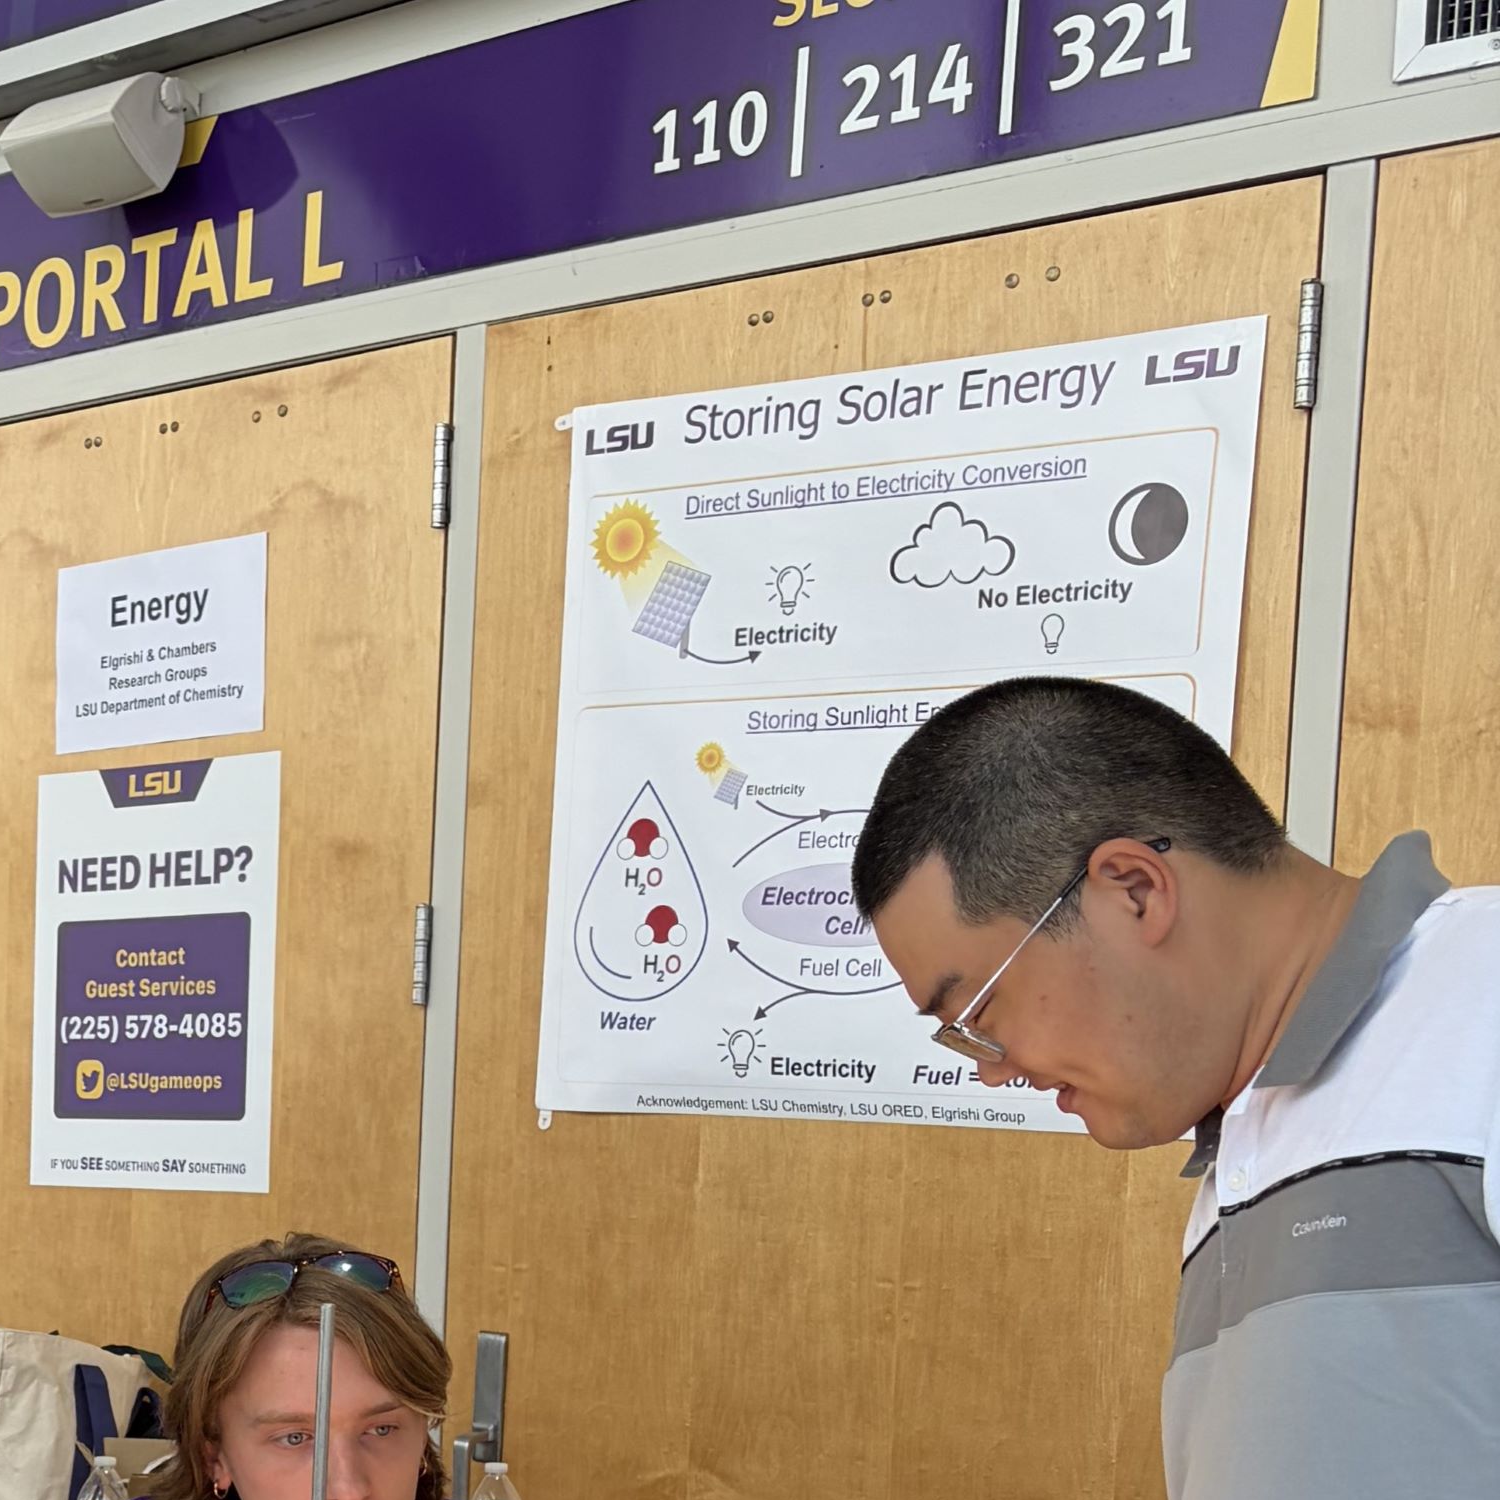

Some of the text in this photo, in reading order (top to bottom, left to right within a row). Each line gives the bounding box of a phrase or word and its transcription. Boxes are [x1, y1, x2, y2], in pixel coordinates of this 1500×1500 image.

[652, 0, 1192, 175] 110 214 321
[302, 190, 344, 288] L
[585, 345, 1241, 456] LSU Storing Solar Energy LSU
[685, 456, 1087, 516] Direct Sunlight to Electricity Conversion
[977, 578, 1133, 609] No Electricity
[110, 588, 209, 628] Energy
[734, 622, 838, 647] Electricity
[100, 640, 217, 671] Elgrishi & Chambers
[108, 664, 208, 690] Research Groups
[75, 683, 244, 718] LSU Department of Chemistry
[747, 709, 818, 732] Storing
[825, 705, 908, 730] Sunlight
[128, 770, 182, 798] LSU
[746, 783, 805, 798] Electricity
[798, 831, 860, 849] Electro
[58, 845, 254, 894] NEED HELP?
[761, 886, 854, 906] Electroc
[825, 916, 866, 935] Cell
[116, 947, 185, 968] Contact
[800, 958, 881, 977] Fuel Cell
[85, 975, 216, 999] Guest Services
[60, 1012, 242, 1044] (225) 578-4085
[599, 1011, 656, 1031] Water
[106, 1071, 222, 1094] @LSUgameops
[770, 1057, 876, 1083] Electricity
[912, 1065, 962, 1087] Fuel
[636, 1094, 1026, 1125] Acknowledgement: LSU Chemistry, LSU ORED, Elgrishi Group
[50, 1156, 246, 1175] IF YOU SEE SOMETHING SAY SOMETHING
